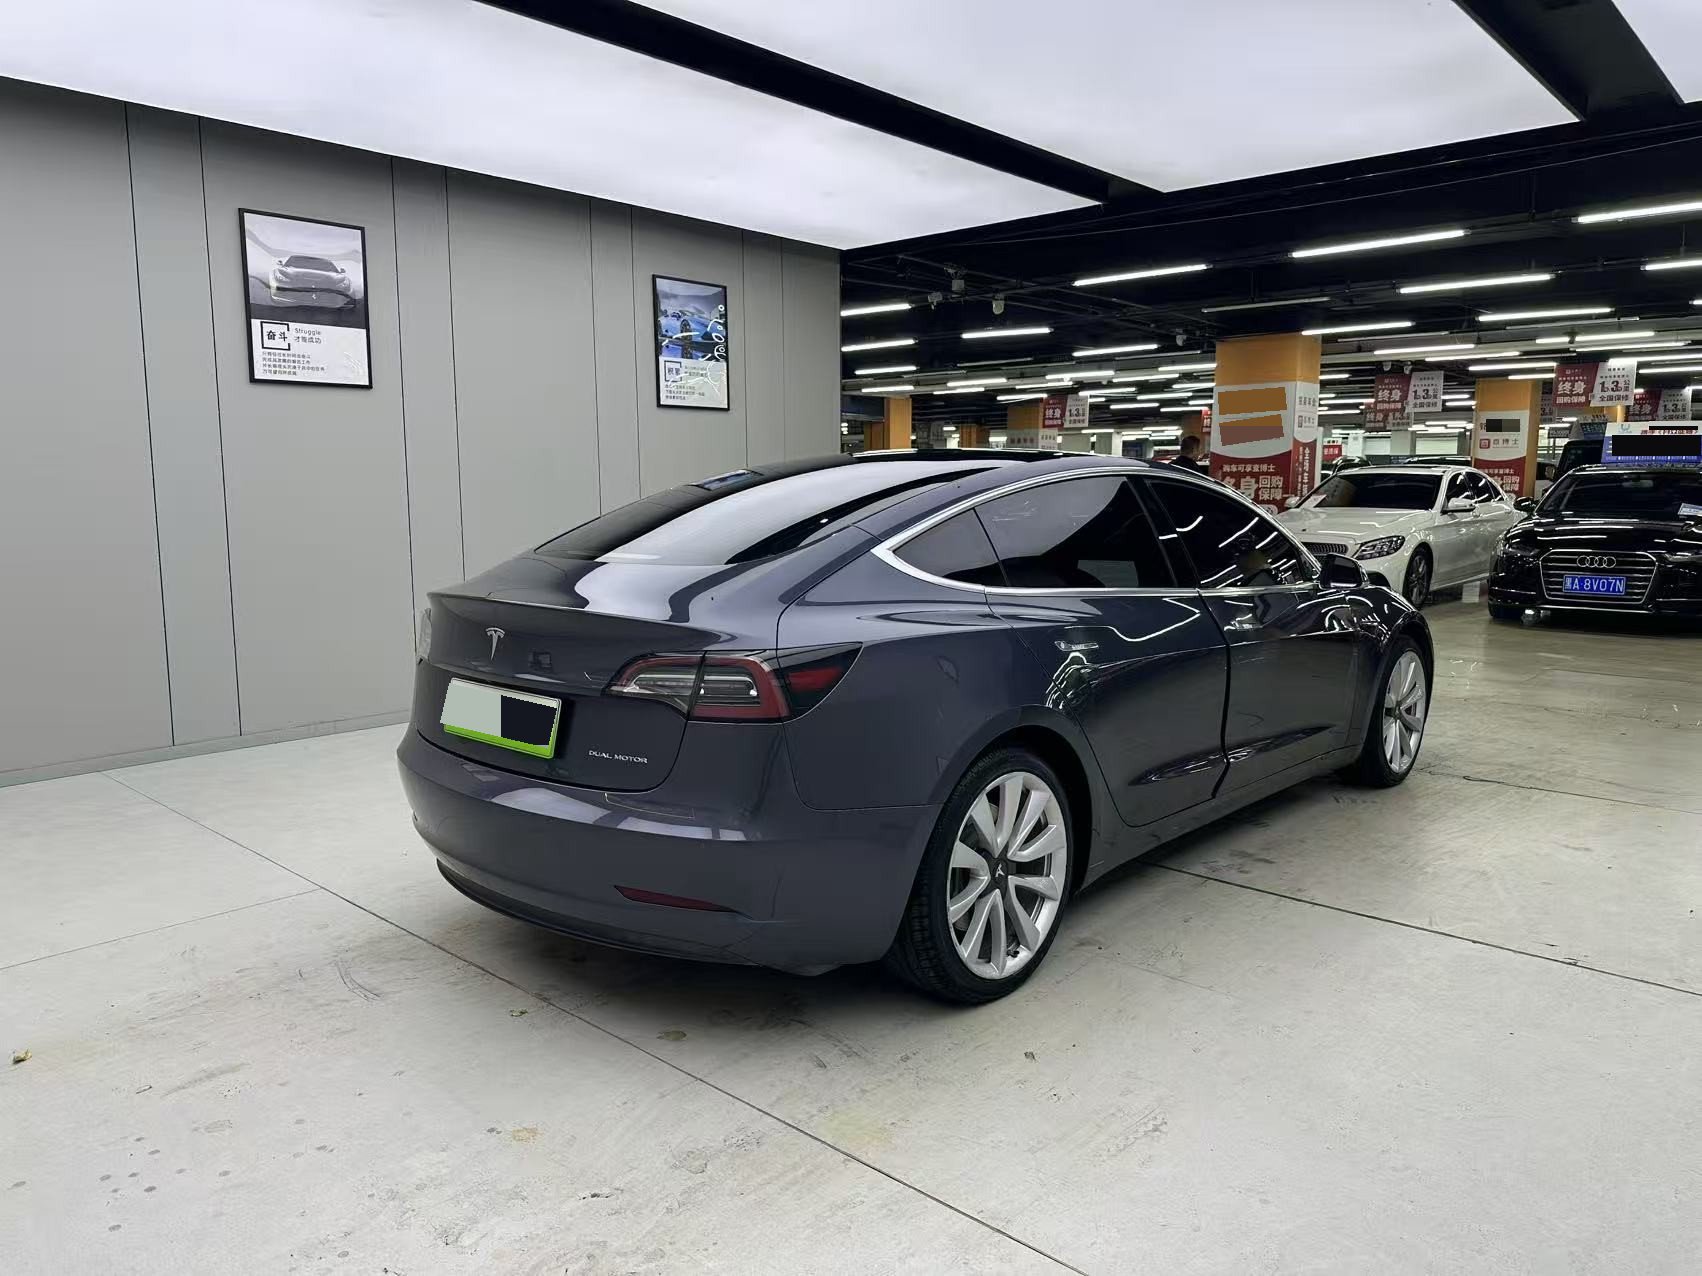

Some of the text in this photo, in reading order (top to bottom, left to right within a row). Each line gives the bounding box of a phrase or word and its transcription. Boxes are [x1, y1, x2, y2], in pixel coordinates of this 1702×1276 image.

[266, 330, 288, 342] 奋斗
[1557, 381, 1587, 395] 终身
[1378, 389, 1402, 401] 终身
[1259, 475, 1283, 488] 回购
[1258, 488, 1283, 500] 保障
[588, 750, 648, 763] DUAL MOTOR
